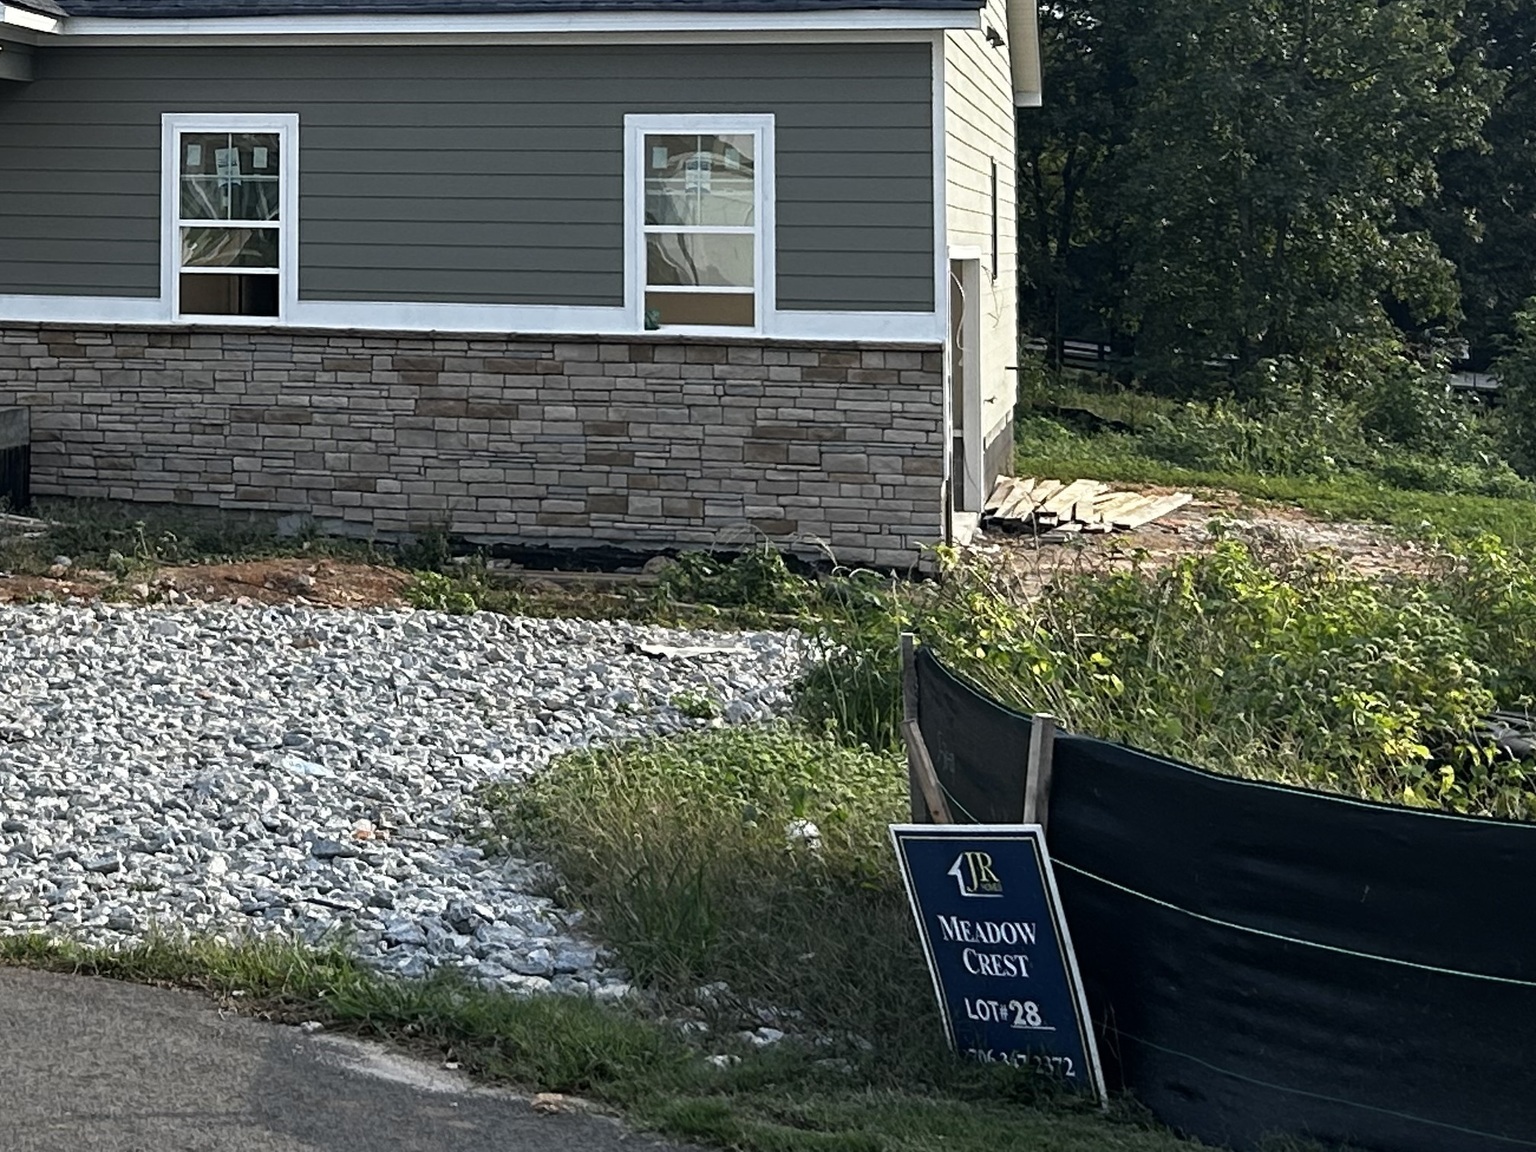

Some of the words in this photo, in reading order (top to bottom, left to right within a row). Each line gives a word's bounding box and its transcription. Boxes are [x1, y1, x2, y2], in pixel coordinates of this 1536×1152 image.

[965, 852, 1000, 893] JR
[937, 914, 1037, 945] MEADOW
[963, 948, 1030, 978] CREST
